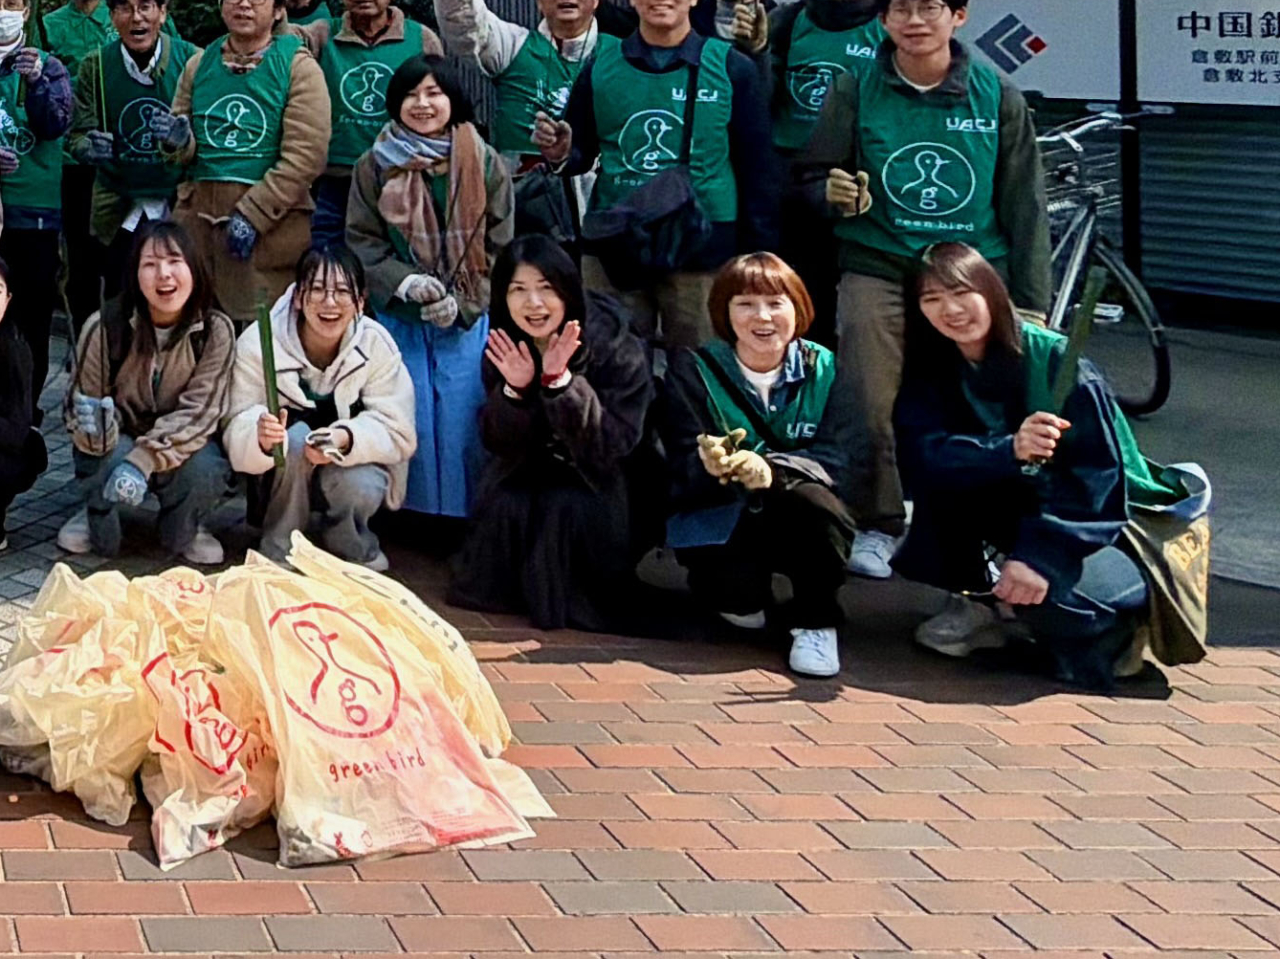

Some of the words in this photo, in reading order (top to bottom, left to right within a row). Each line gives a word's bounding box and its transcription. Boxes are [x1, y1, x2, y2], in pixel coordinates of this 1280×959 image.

[946, 117, 997, 132] UACJ
[329, 760, 385, 782] green
[385, 747, 426, 771] bird
